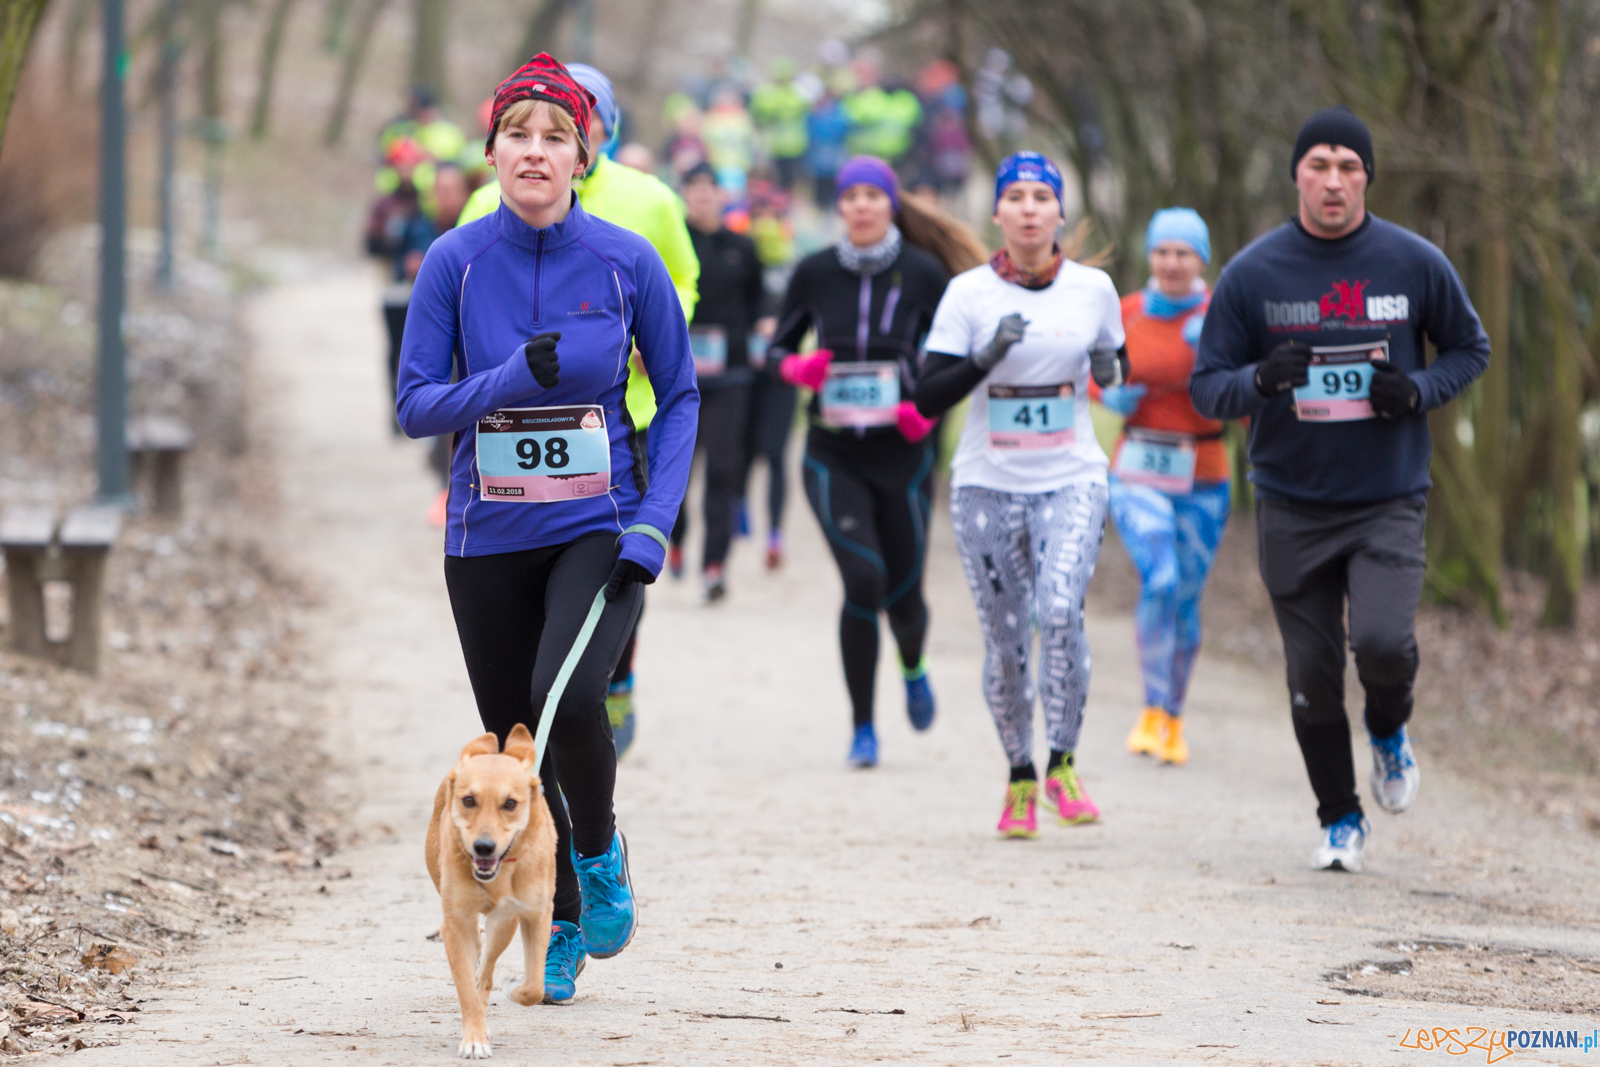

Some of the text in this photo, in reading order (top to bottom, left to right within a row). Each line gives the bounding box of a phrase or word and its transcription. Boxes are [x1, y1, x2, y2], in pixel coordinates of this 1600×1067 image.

[1264, 300, 1320, 327] bone
[1366, 294, 1409, 321] usa
[1322, 370, 1363, 396] 99
[1013, 403, 1050, 428] 41
[516, 437, 570, 470] 98
[489, 487, 523, 495] 11.02.2018
